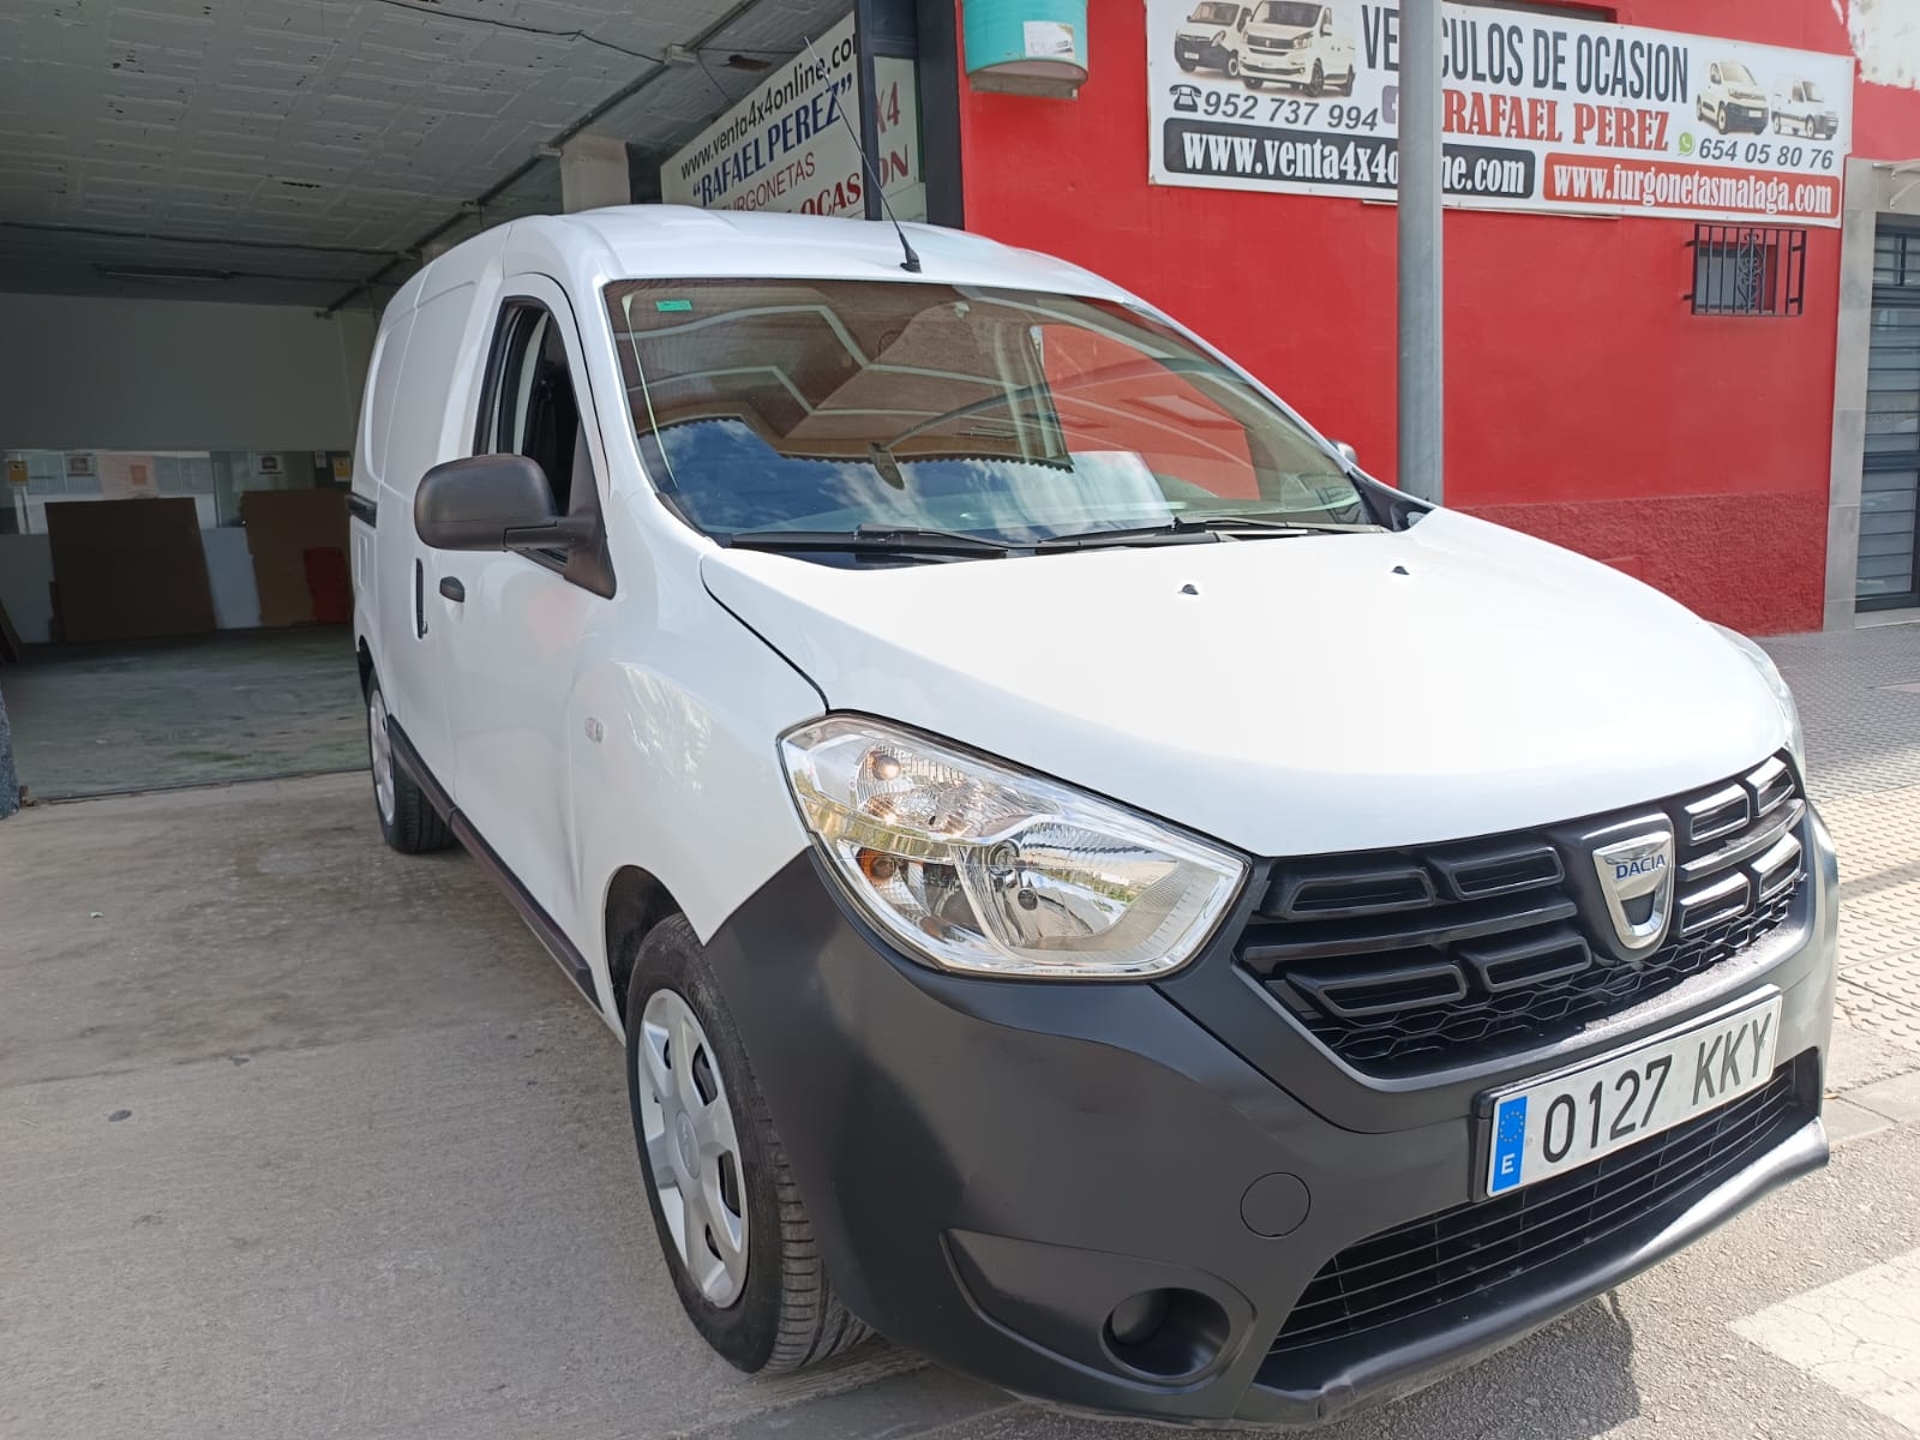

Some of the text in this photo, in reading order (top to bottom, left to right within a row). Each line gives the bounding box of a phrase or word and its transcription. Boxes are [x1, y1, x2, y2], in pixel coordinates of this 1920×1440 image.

[1362, 5, 1688, 103] VEULOS DE OCASION
[1203, 90, 1378, 132] 952 737 994
[1442, 89, 1669, 151] RAFAEL PEREZ
[1182, 131, 1525, 194] www.venta4x4one.com
[1699, 138, 1834, 170] 654 05 80 76
[721, 152, 816, 212] RGONETAS
[1553, 164, 1832, 215] www.furgonetasmalaga.com
[1615, 853, 1667, 880] DACIA
[1542, 1012, 1772, 1163] 0127 KKY
[1501, 1153, 1515, 1175] E
